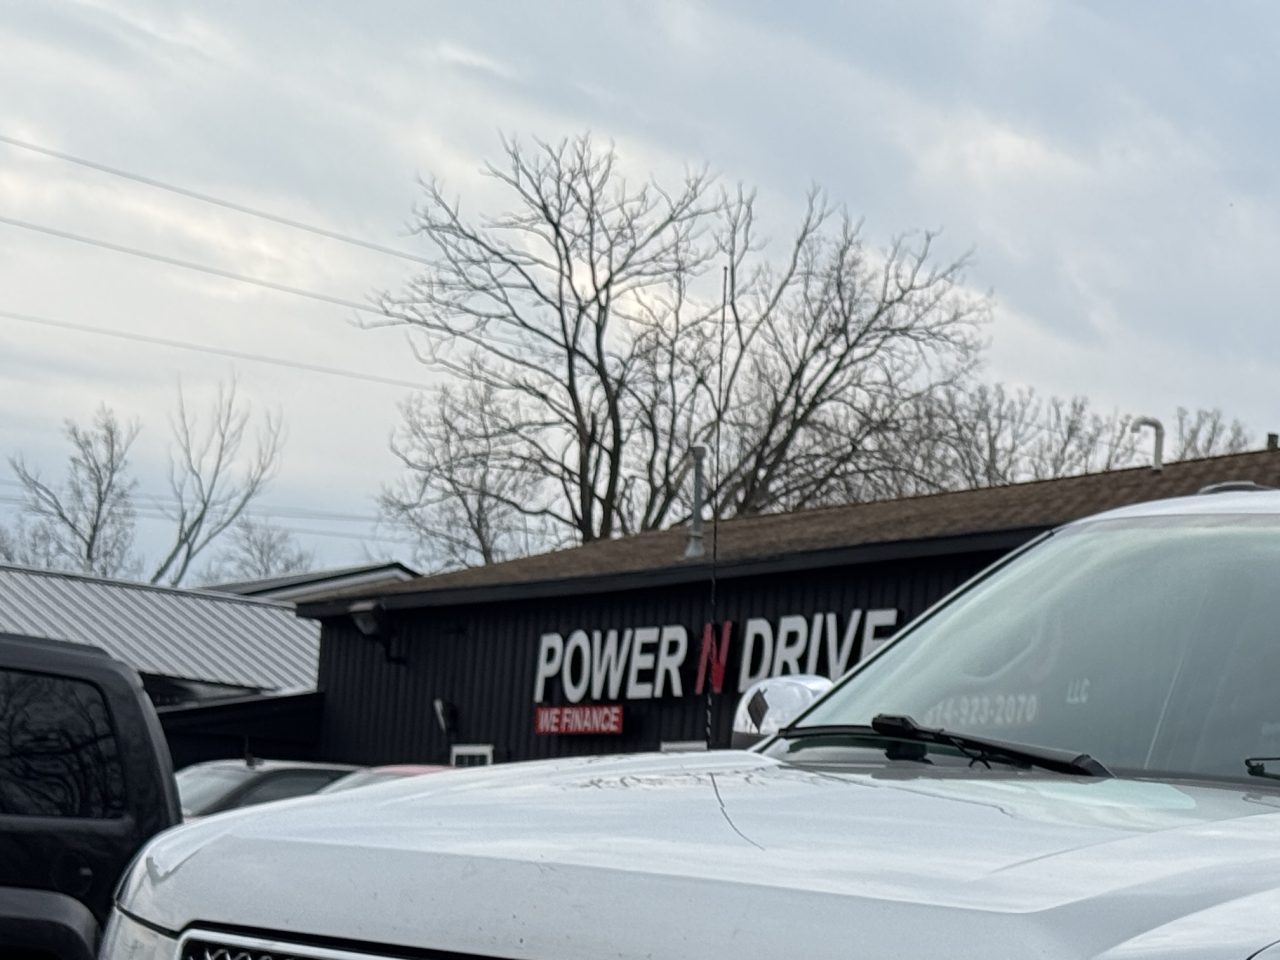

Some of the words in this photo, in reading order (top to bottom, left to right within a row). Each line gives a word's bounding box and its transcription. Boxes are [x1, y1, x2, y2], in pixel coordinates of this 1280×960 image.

[534, 625, 688, 703] POWER
[695, 620, 732, 695] N
[538, 706, 559, 733] WE
[561, 705, 620, 733] FINANCE
